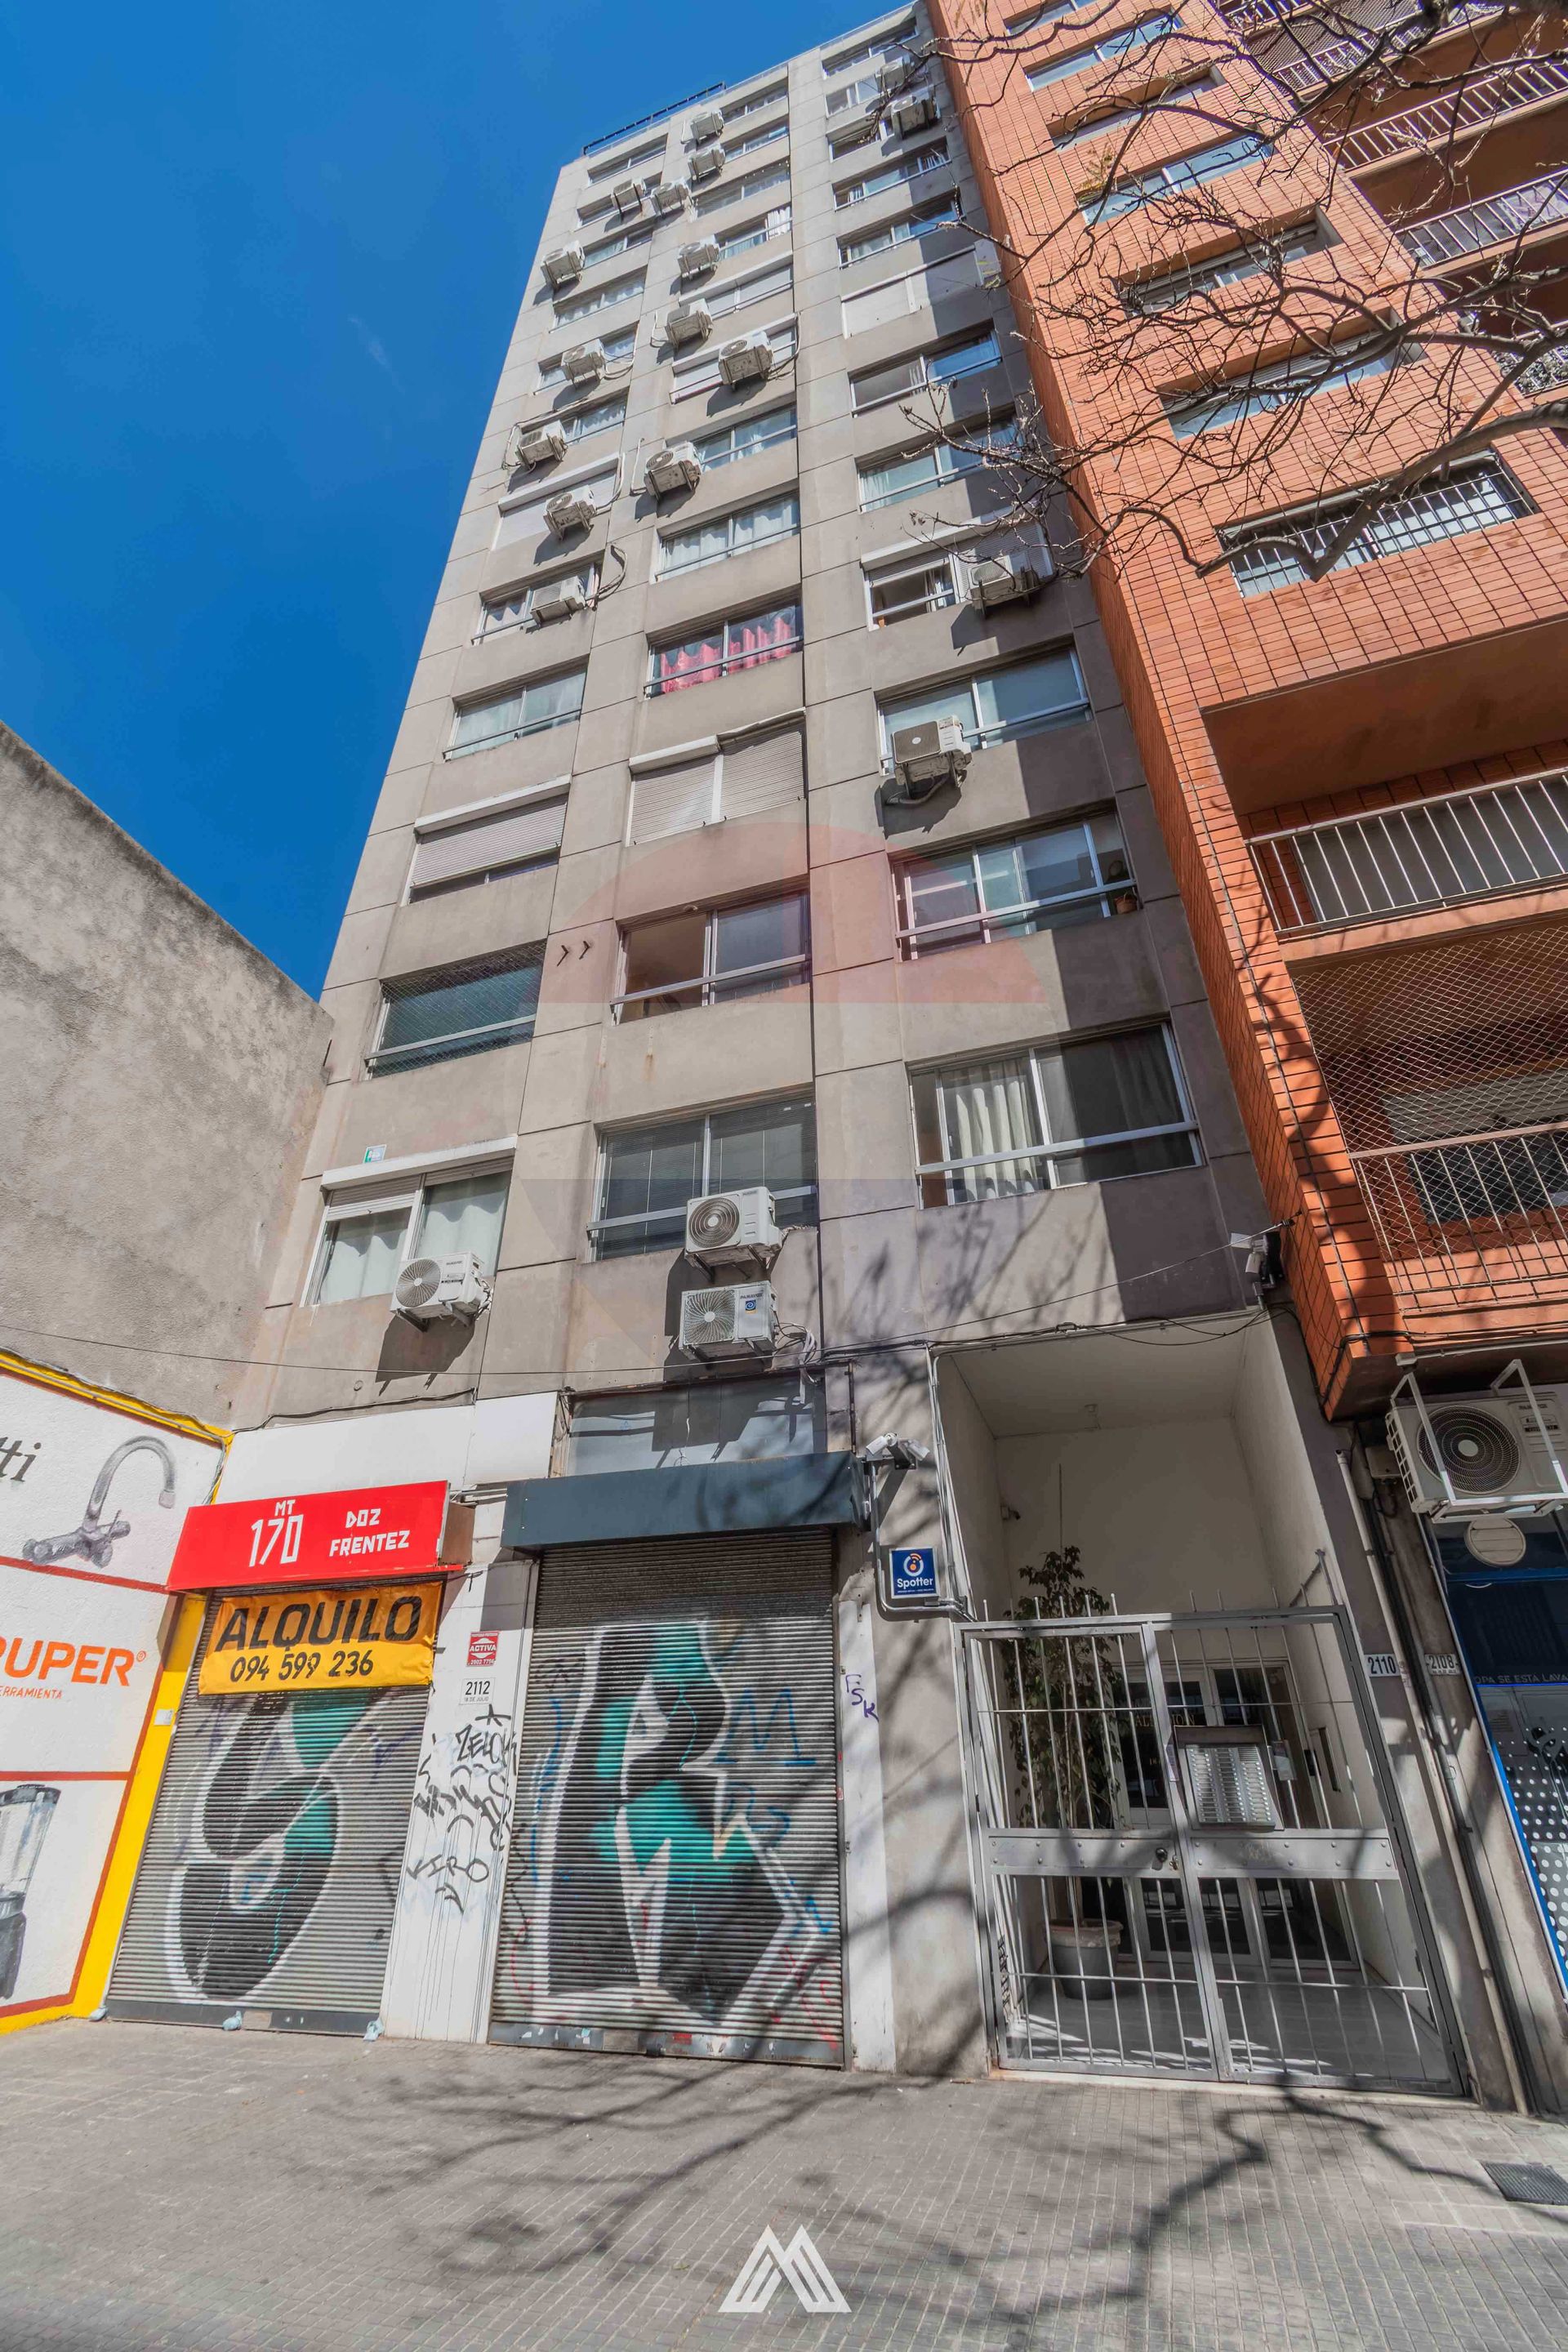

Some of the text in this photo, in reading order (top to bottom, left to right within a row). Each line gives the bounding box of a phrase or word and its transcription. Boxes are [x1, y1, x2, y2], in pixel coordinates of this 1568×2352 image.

[274, 1499, 296, 1517] MT
[249, 1513, 304, 1567] 170
[897, 1577, 933, 1589] Spotter
[215, 1596, 422, 1652] ALQUILO
[0, 1636, 131, 1686] UPER
[230, 1650, 373, 1682] 094 599 236
[1368, 1656, 1396, 1674] 2110
[1428, 1655, 1454, 1669] 2108
[466, 1681, 491, 1695] 2112
[1498, 1675, 1510, 1683] SE
